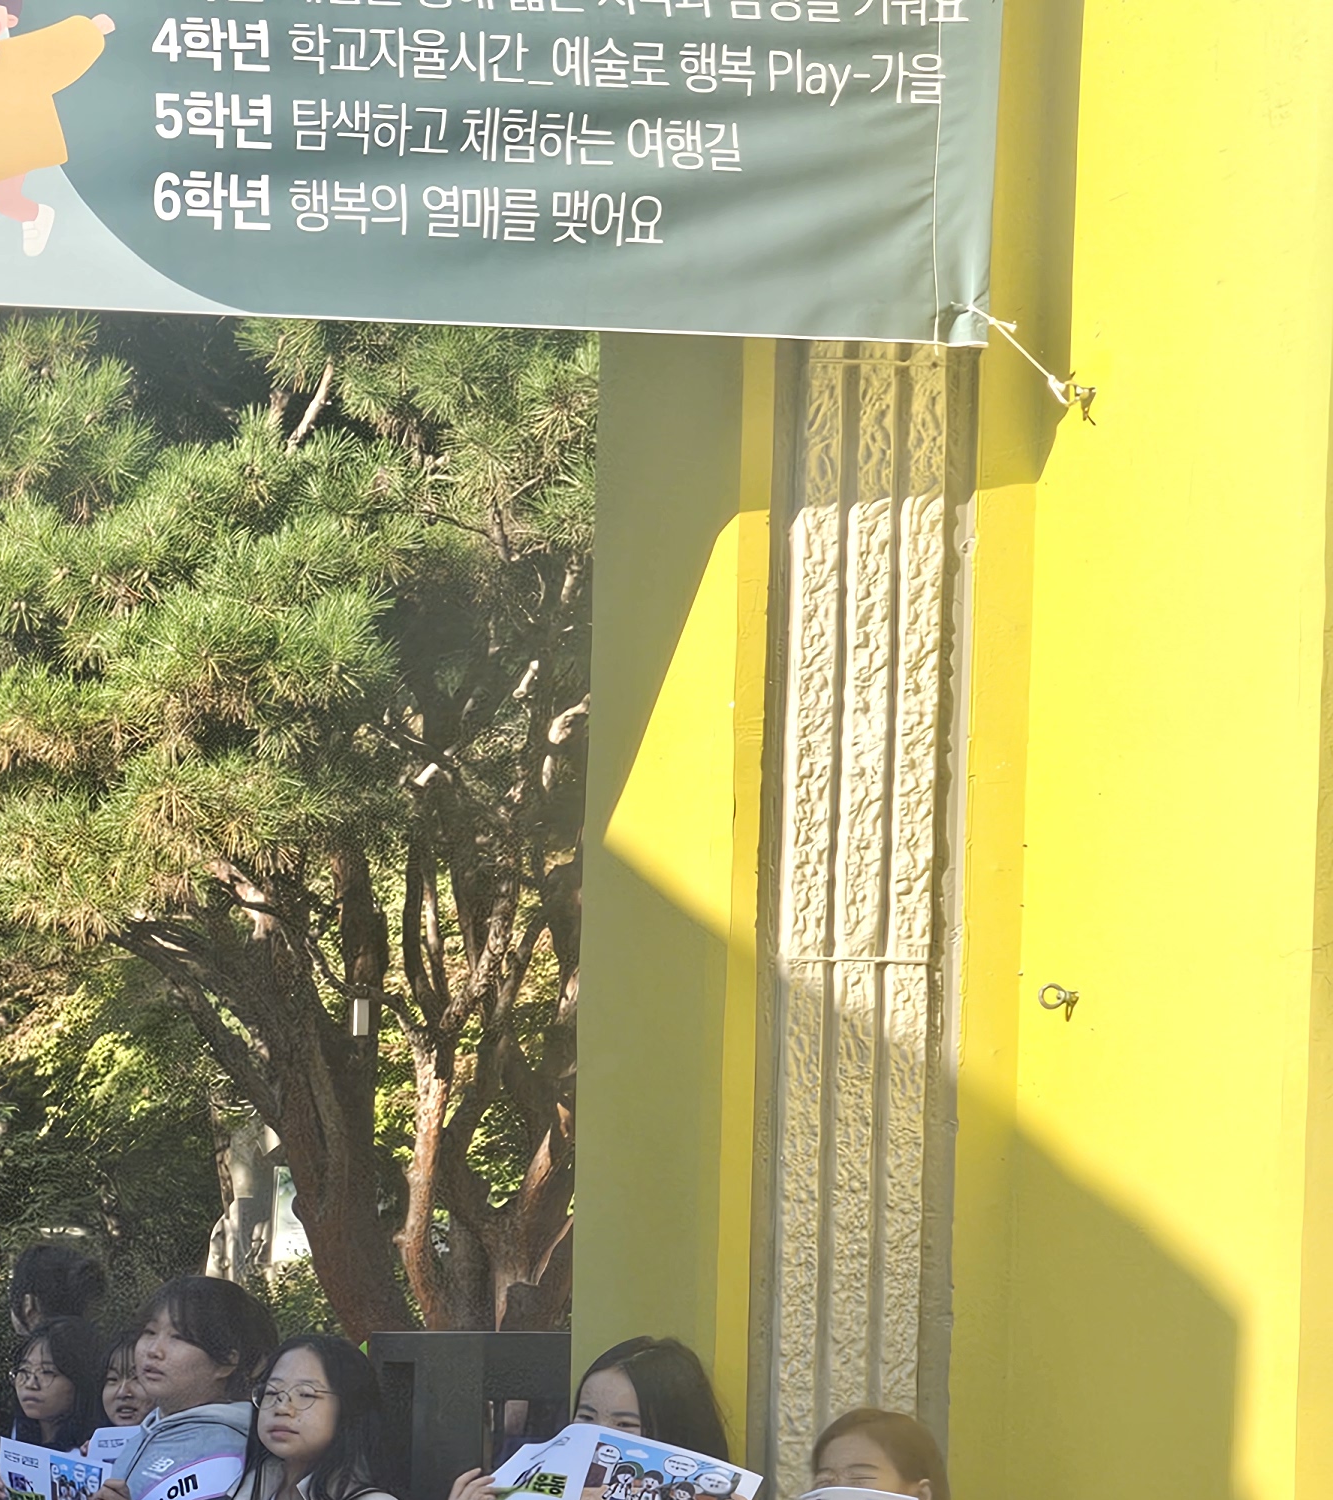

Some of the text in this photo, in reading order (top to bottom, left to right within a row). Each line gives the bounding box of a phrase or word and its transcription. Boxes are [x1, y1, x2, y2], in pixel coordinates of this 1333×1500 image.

[151, 17, 271, 74] 4학년
[679, 41, 756, 97] 행복
[768, 49, 947, 106] Play-가을
[153, 91, 744, 173] 5학년 탐색하고 체험하는 여행길
[152, 170, 664, 247] 6학년 행복의 열매를 맺어요
